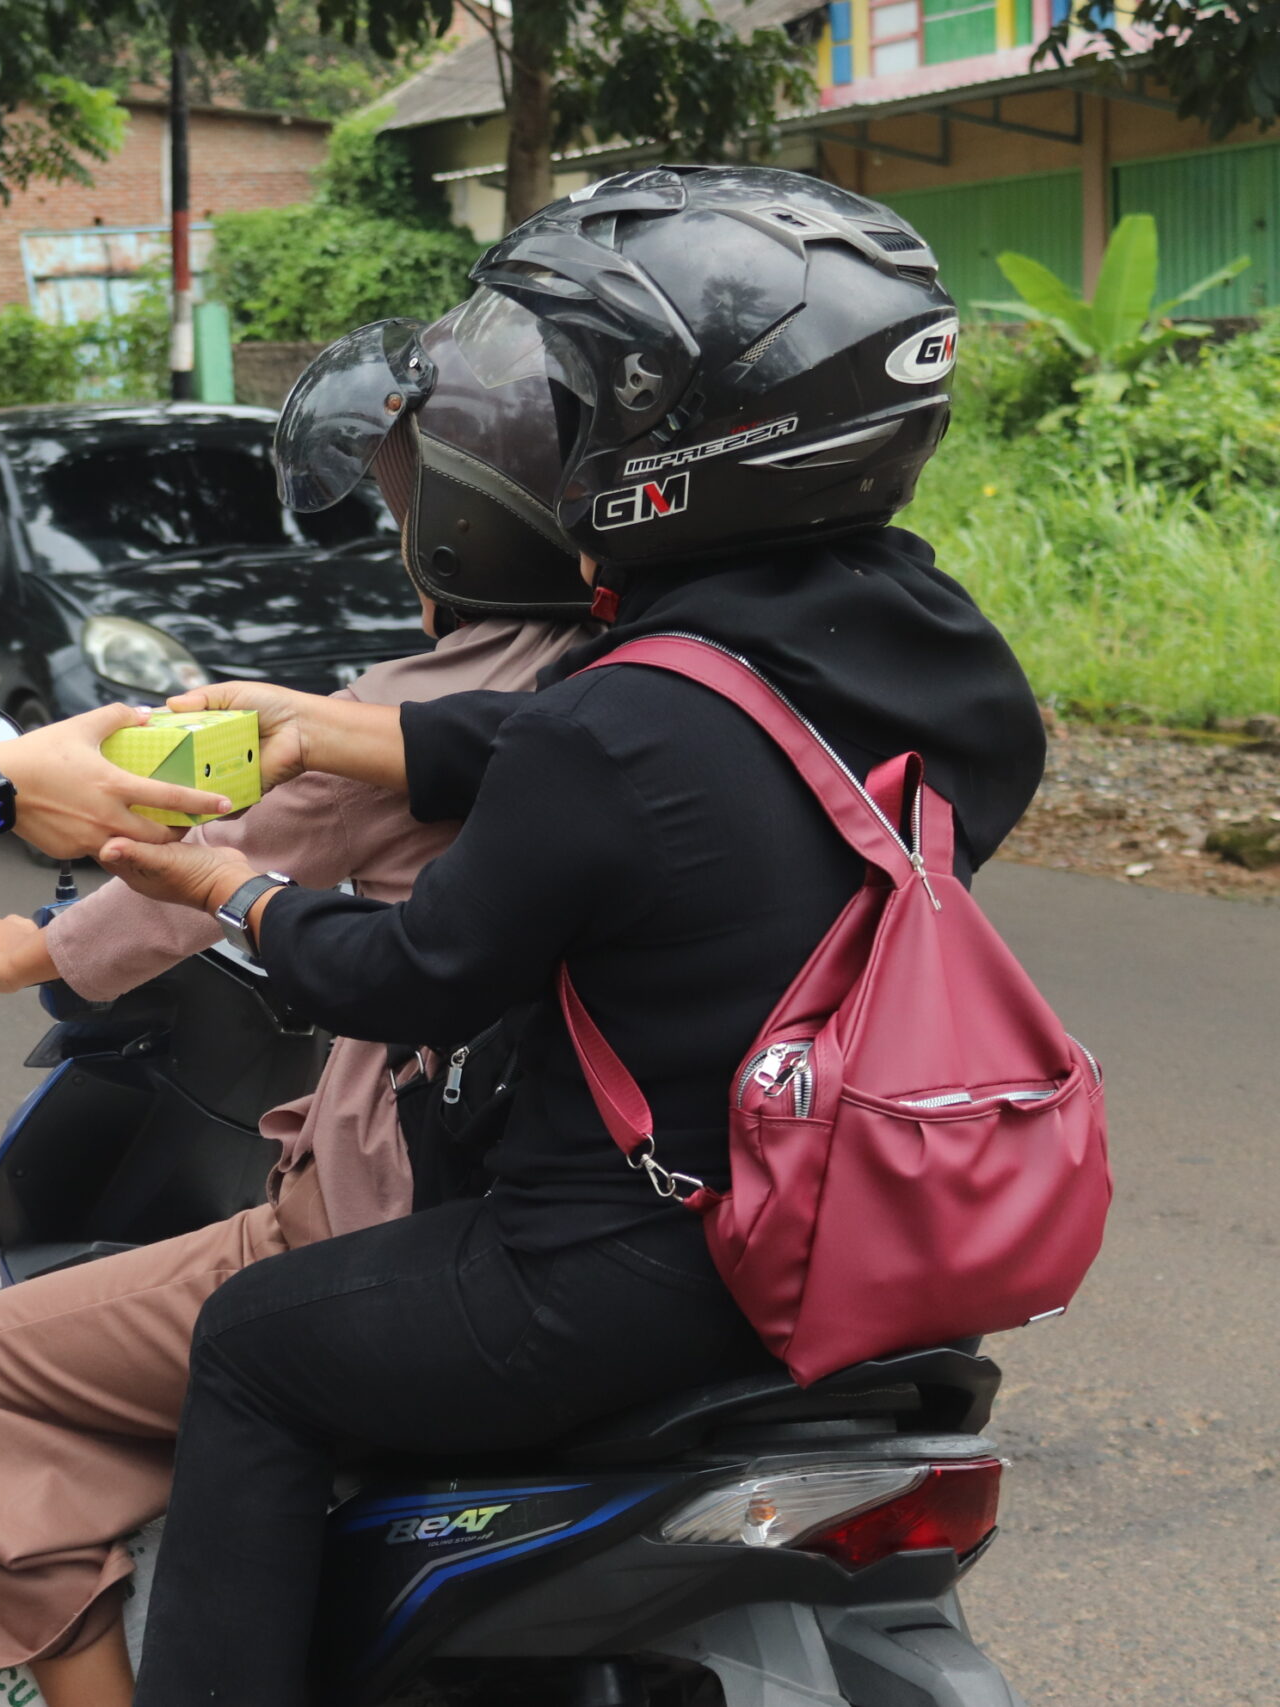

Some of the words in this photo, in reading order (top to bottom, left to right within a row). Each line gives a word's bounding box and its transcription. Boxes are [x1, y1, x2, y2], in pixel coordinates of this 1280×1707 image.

[915, 332, 957, 365] GM
[593, 472, 690, 531] GM
[455, 1535, 477, 1544] STOP
